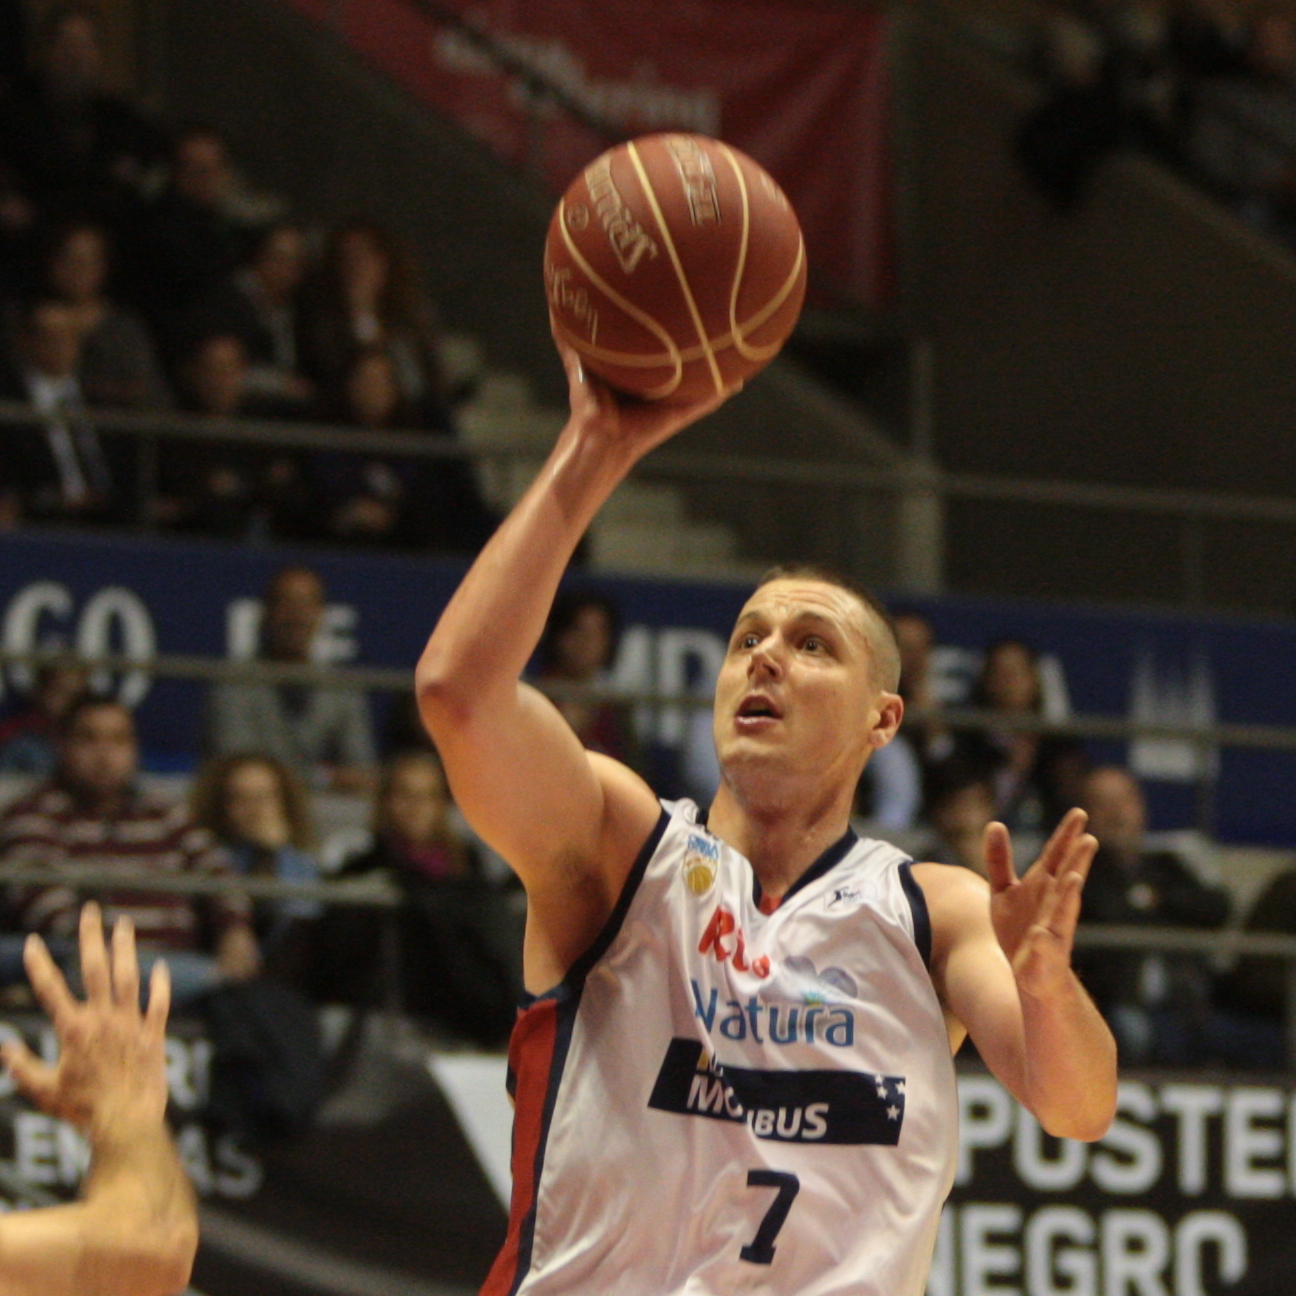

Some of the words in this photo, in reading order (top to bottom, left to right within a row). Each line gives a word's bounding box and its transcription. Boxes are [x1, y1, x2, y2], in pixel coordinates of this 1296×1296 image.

[690, 980, 856, 1048] Natura
[685, 1072, 830, 1141] MOBUS
[739, 1169, 801, 1266] 7
